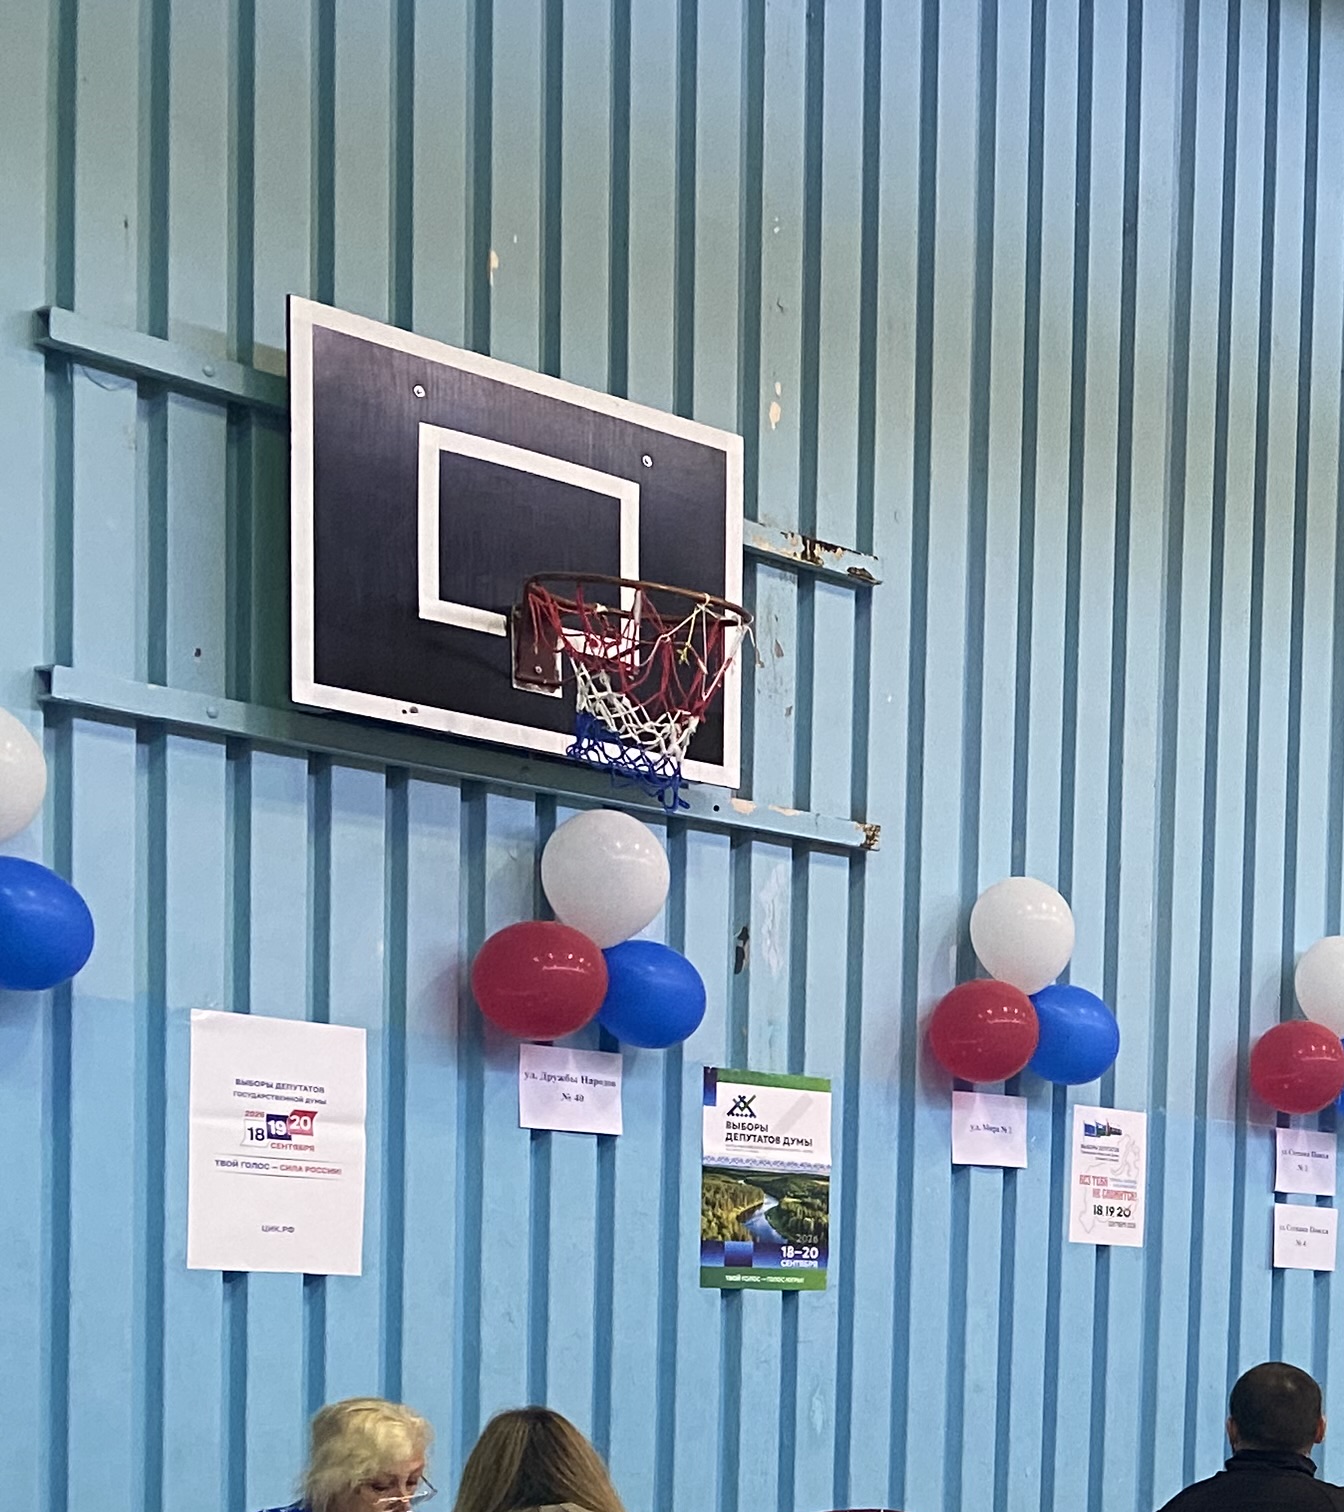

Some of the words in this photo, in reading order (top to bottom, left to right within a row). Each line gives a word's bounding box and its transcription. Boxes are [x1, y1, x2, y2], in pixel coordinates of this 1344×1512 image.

[235, 1078, 274, 1089] ВЫБОРЫ
[275, 1082, 325, 1094] ДЕПУТАТОВ
[247, 1126, 266, 1141] 18
[267, 1120, 288, 1136] 19
[289, 1114, 312, 1131] 20
[725, 1120, 769, 1133] ВЫБОРЫ
[724, 1132, 781, 1145] ДЕПУТАТОВ
[782, 1136, 814, 1147] ДУМЫ
[214, 1159, 239, 1168] ТВОЙ
[240, 1161, 271, 1171] ГОЛОС
